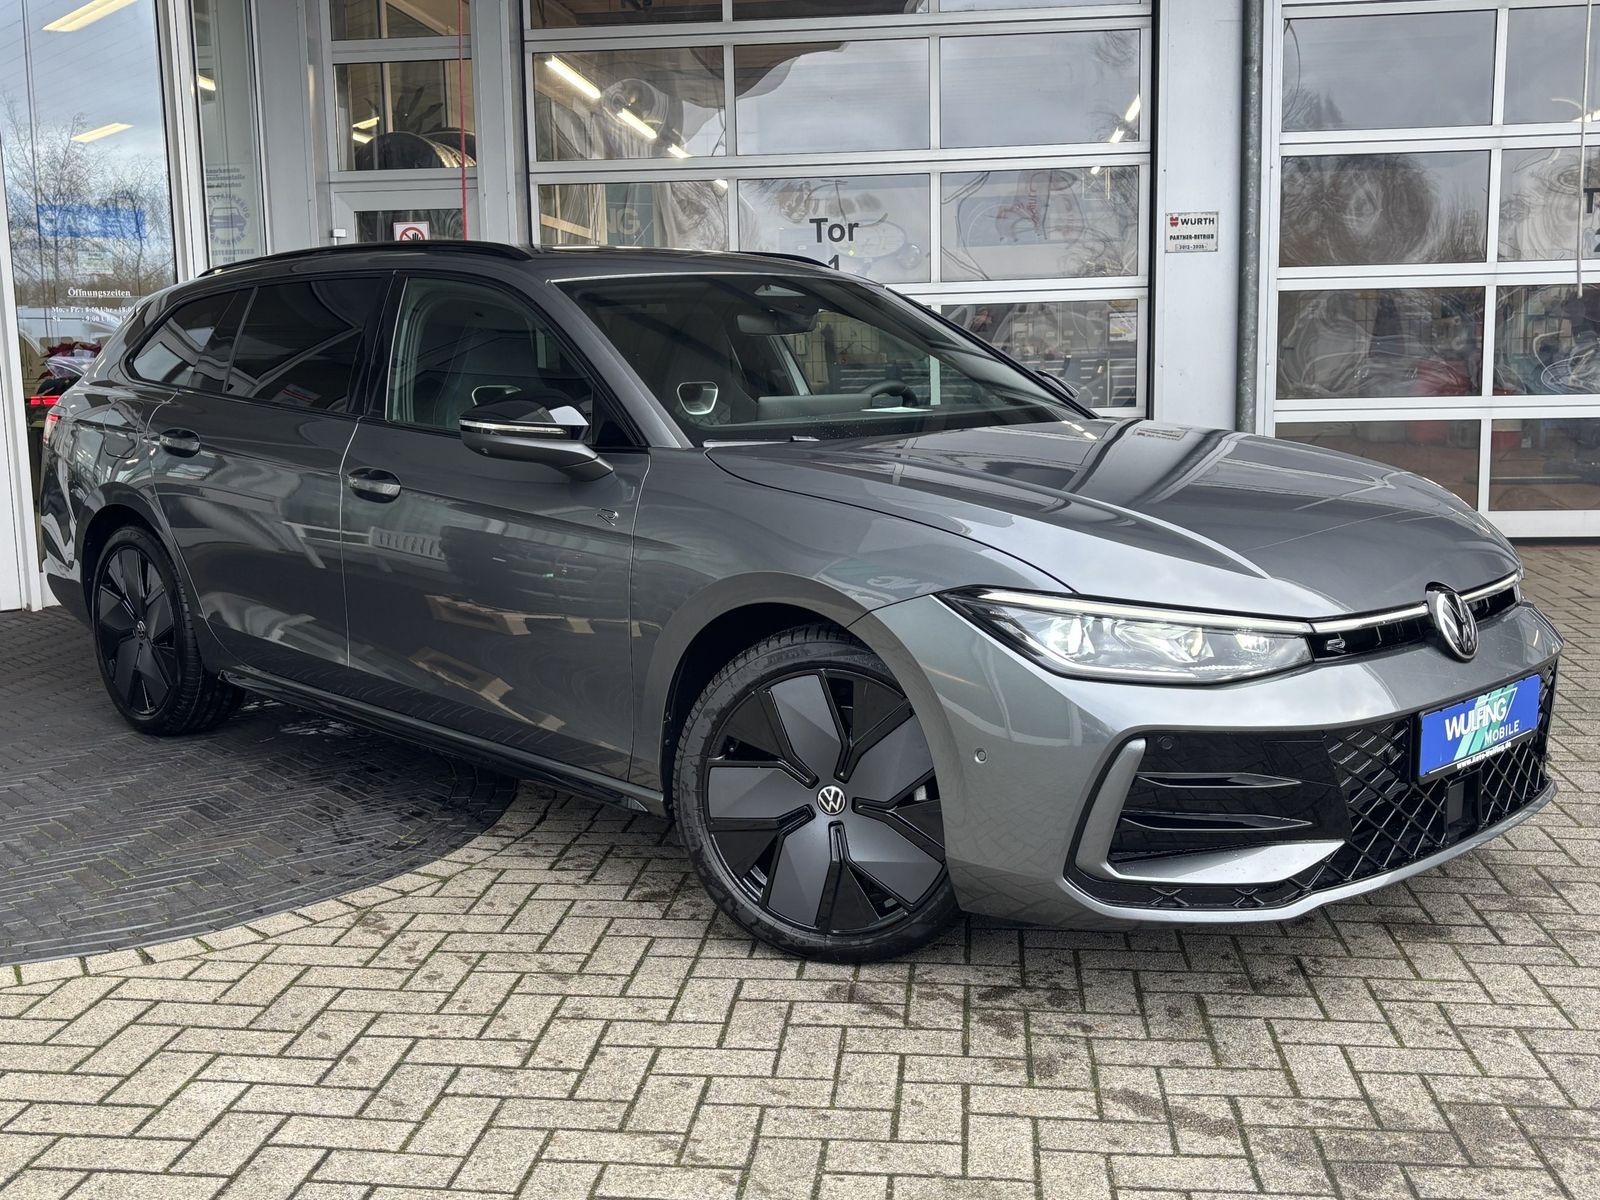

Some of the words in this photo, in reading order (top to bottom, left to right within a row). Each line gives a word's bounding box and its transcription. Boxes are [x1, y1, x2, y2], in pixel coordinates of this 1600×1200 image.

[808, 217, 860, 243] Tor
[67, 287, 131, 298] Öffnungszeiten
[1484, 719, 1520, 746] MOBILE
